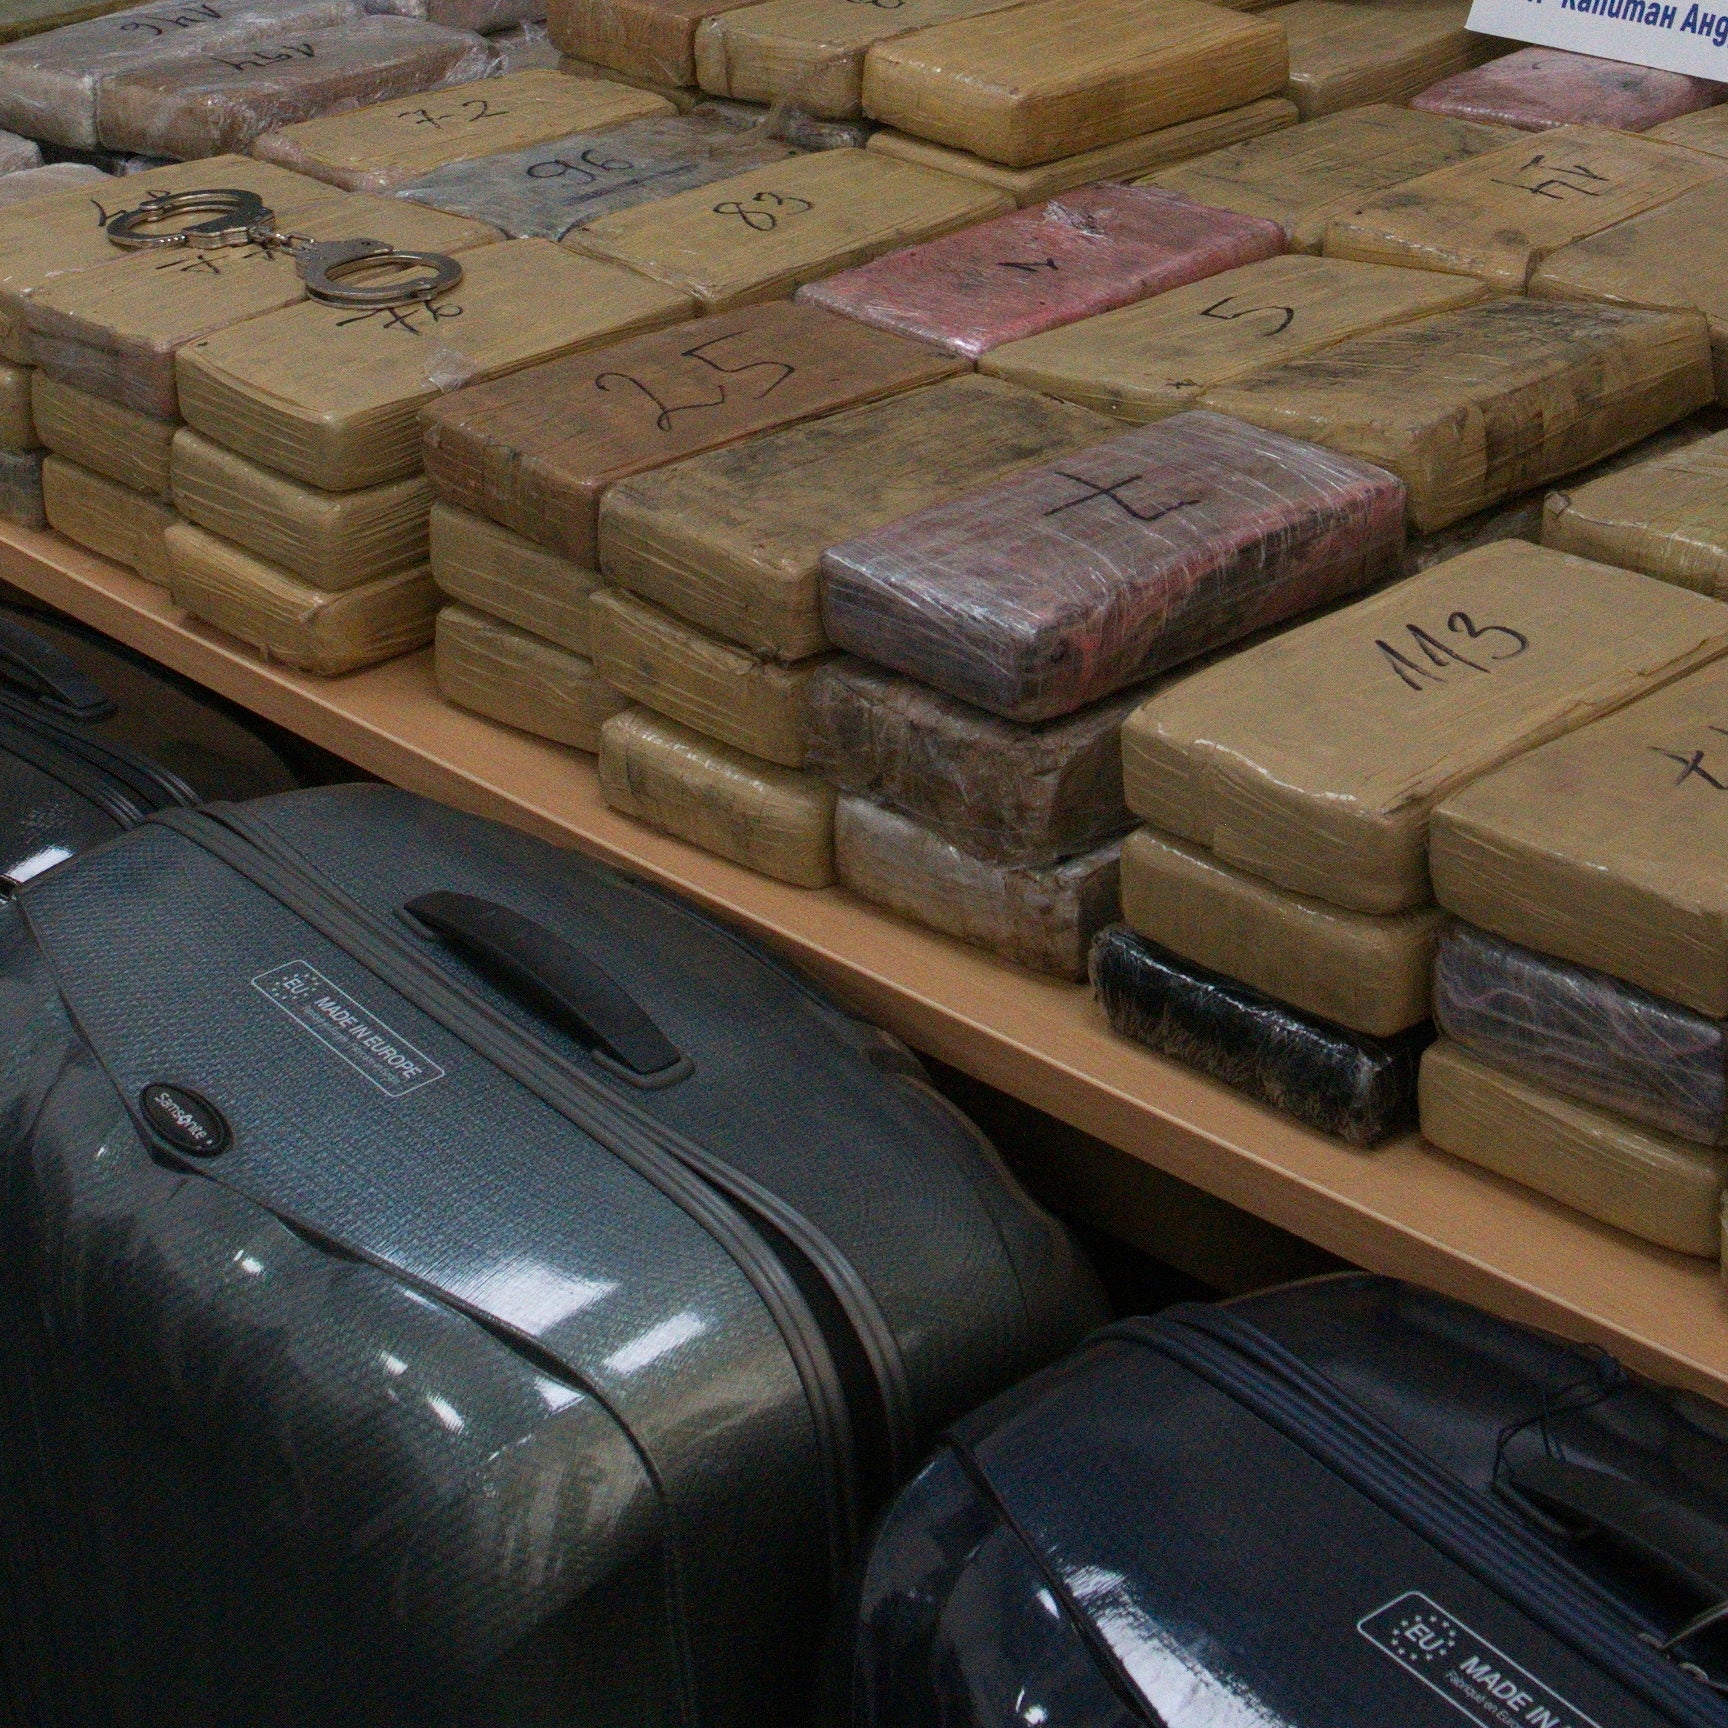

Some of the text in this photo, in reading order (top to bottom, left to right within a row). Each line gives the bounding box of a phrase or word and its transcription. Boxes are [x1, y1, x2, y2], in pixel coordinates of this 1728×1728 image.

[283, 977, 310, 995] EU
[314, 996, 422, 1079] MADE IN EUROPE
[154, 1092, 208, 1140] Samsonite
[1405, 1622, 1445, 1652] EU
[1459, 1655, 1534, 1712] MADE
